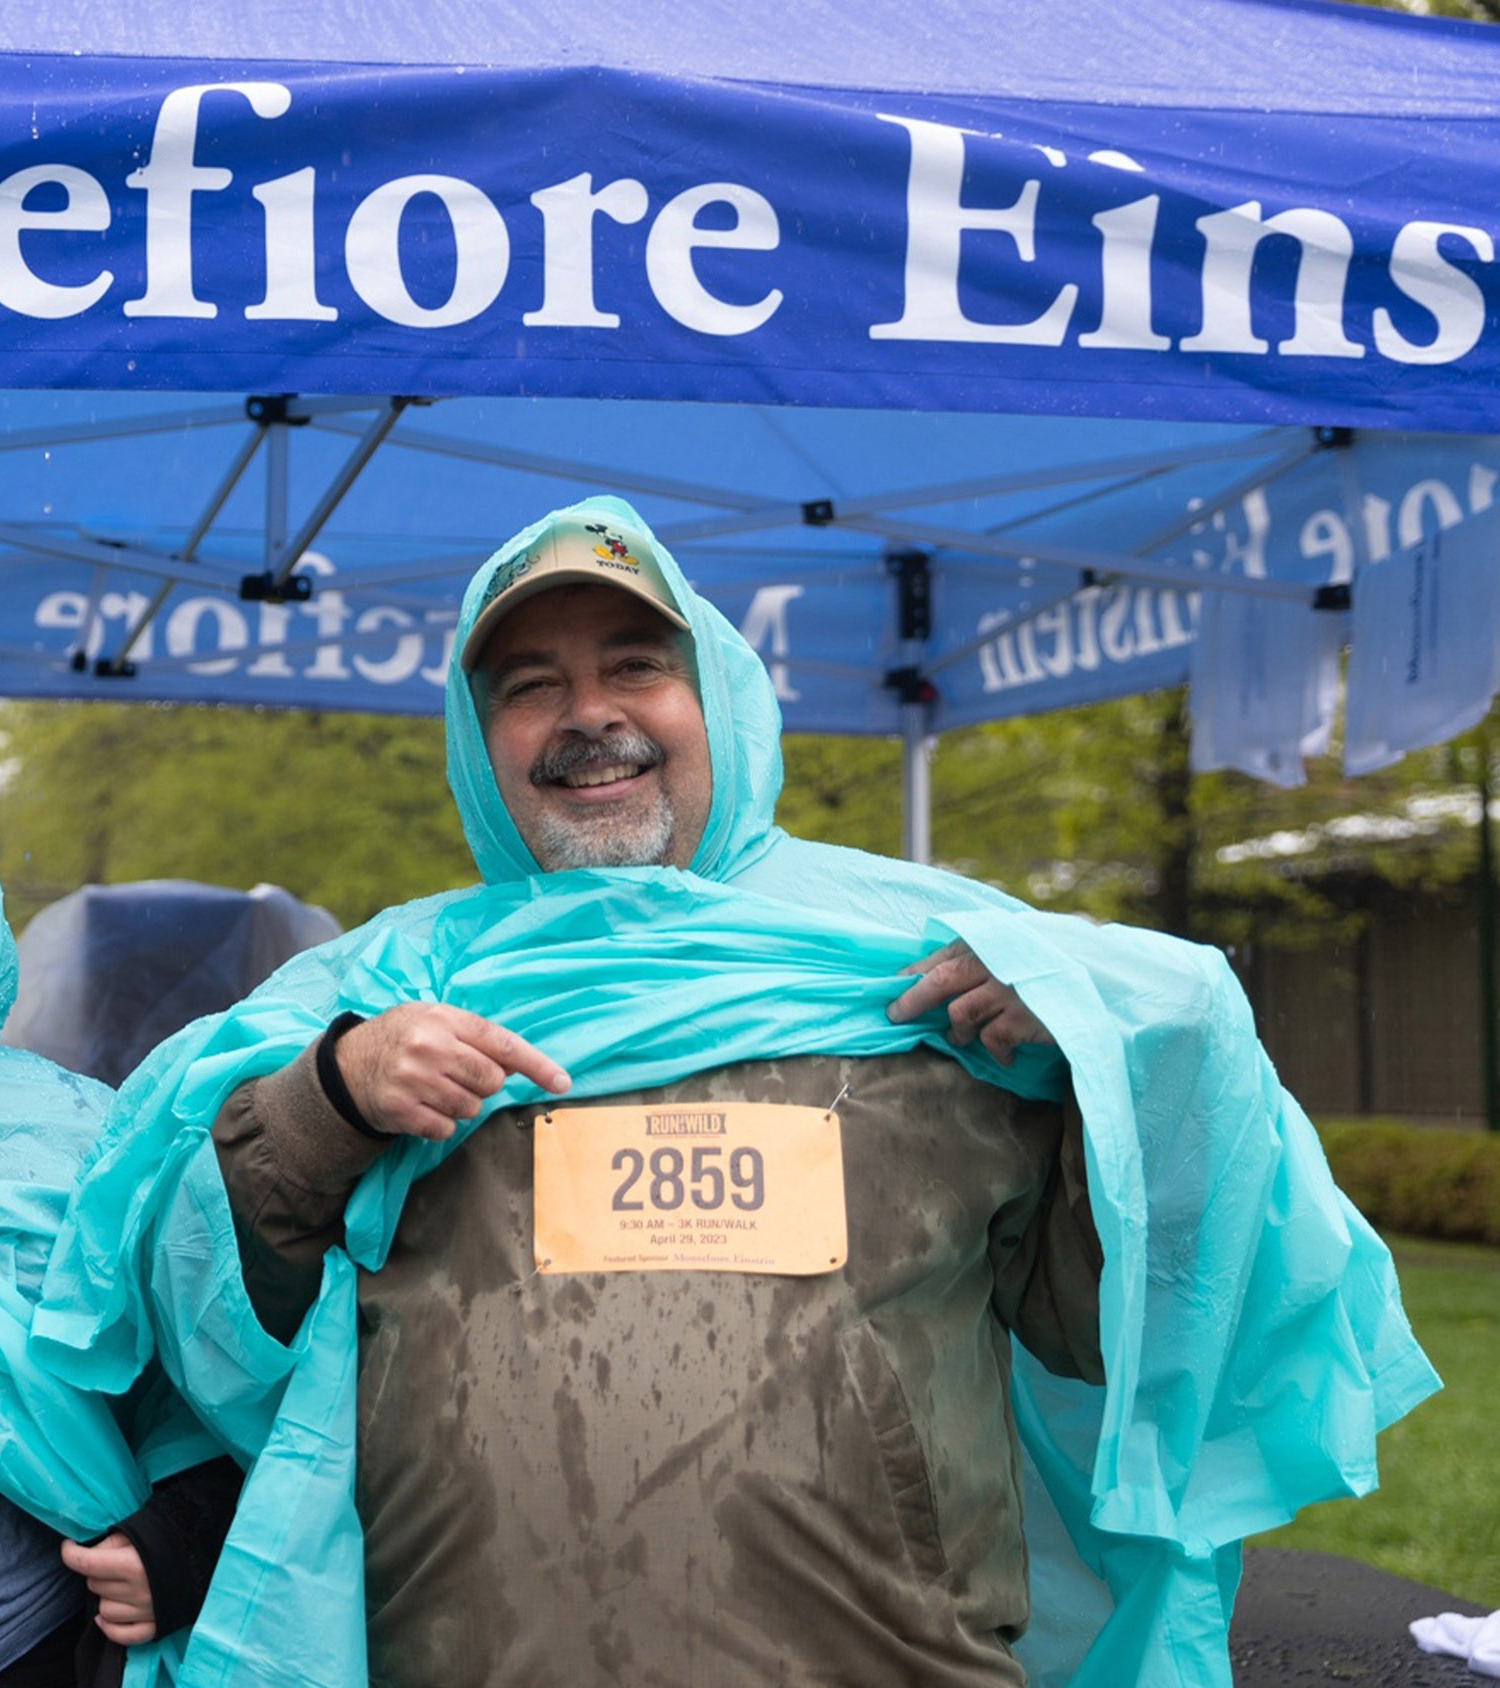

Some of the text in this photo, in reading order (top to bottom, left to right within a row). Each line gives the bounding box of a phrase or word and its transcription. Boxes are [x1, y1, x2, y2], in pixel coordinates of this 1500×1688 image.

[869, 113, 1496, 364] Eins
[651, 1115, 678, 1133] RUN
[685, 1114, 721, 1133] WILD
[611, 1146, 765, 1212] 2859
[619, 1220, 643, 1230] 9:30
[646, 1219, 664, 1229] AM
[678, 1219, 693, 1229] 3K
[696, 1219, 757, 1230] RUN/WALK
[650, 1234, 676, 1246] April
[699, 1234, 727, 1244] 2023
